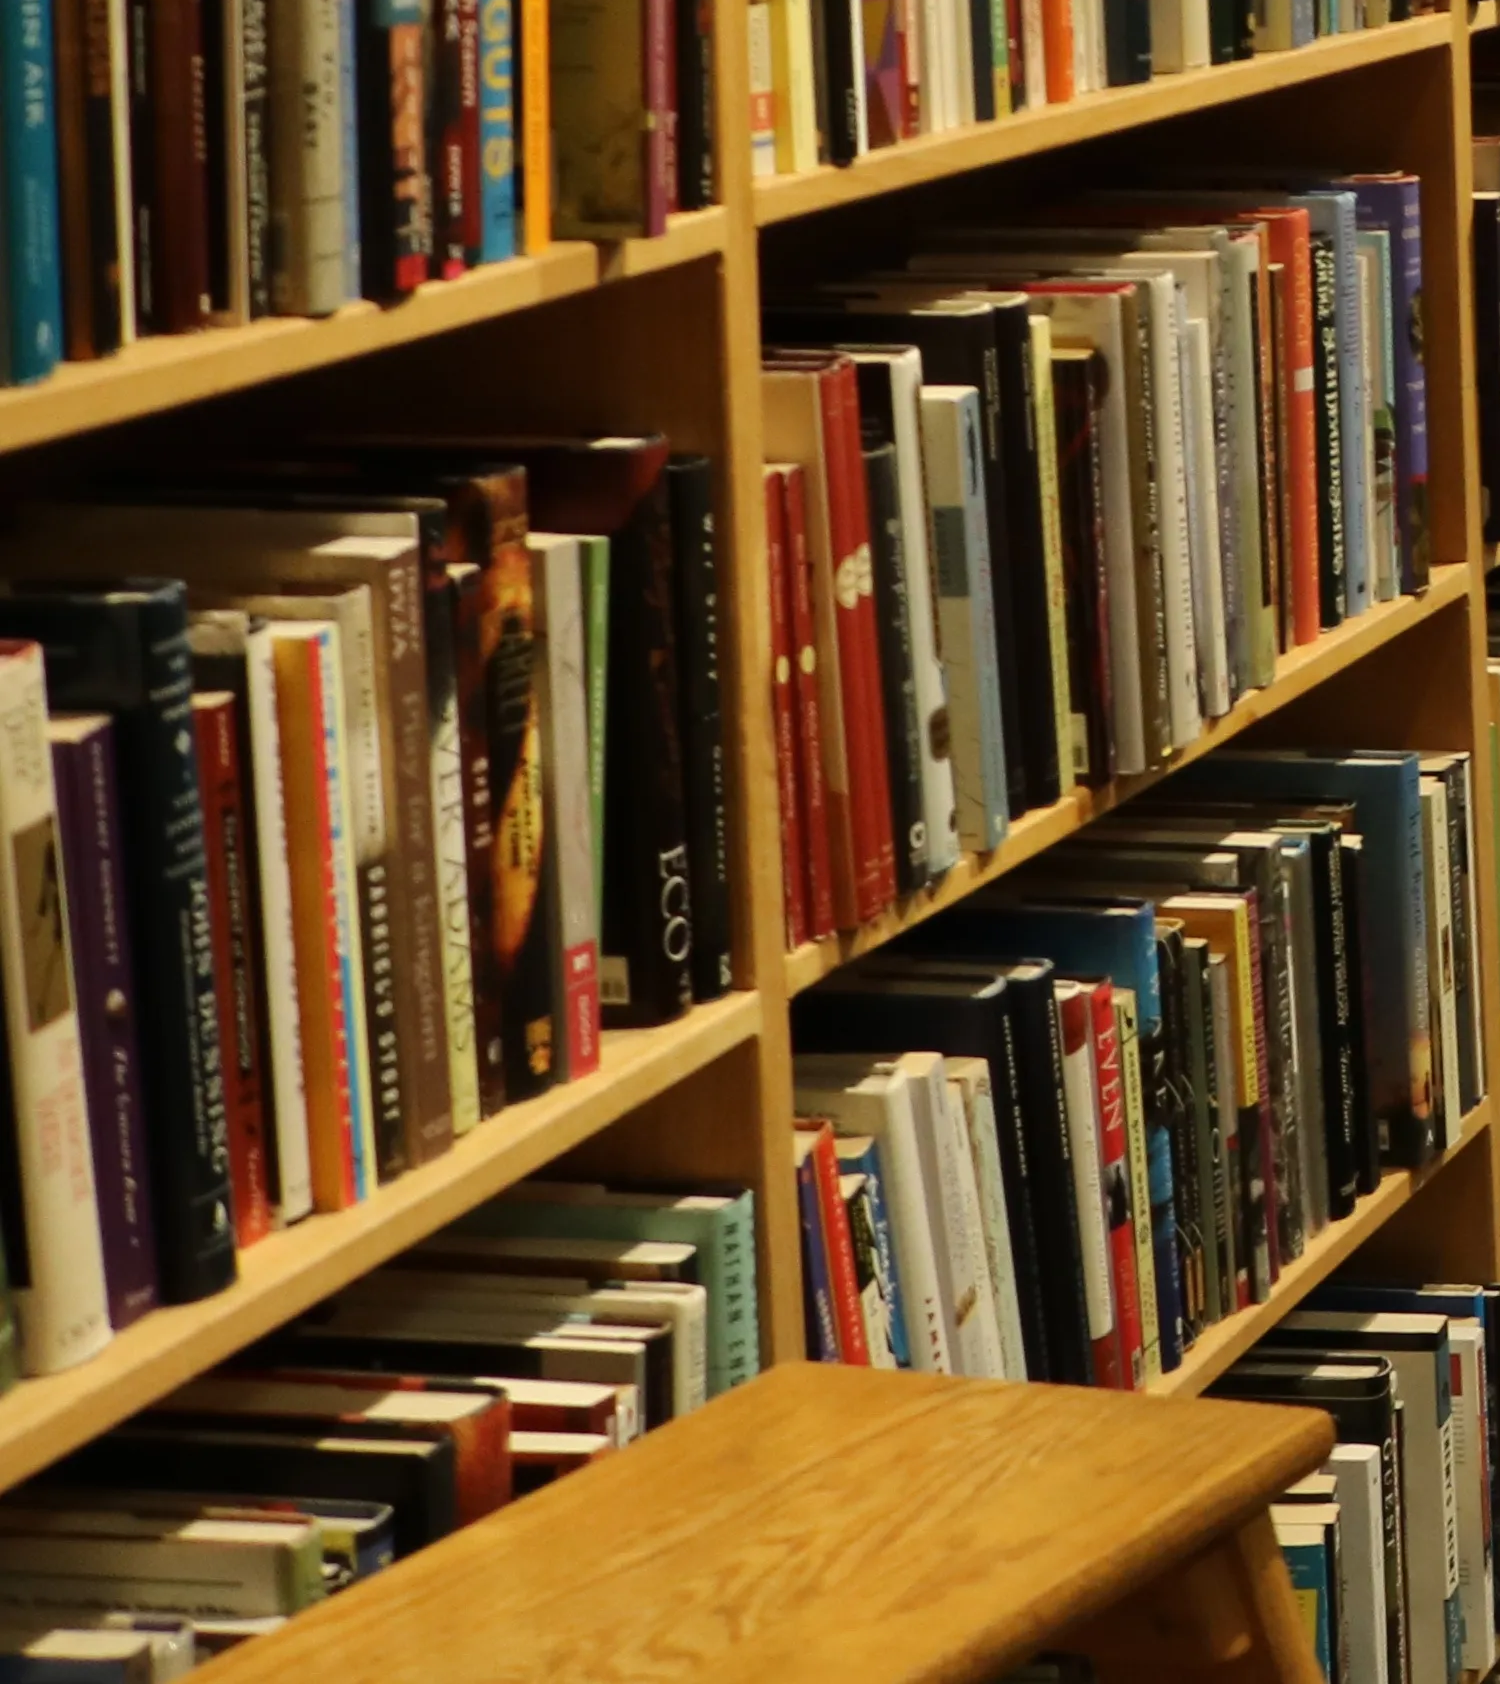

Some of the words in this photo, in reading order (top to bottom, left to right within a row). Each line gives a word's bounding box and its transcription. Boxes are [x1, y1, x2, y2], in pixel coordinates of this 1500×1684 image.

[23, 62, 44, 129] AIR
[462, 20, 478, 107] Season
[400, 691, 426, 775] Play
[405, 794, 428, 850] for
[188, 878, 213, 976] JOHN
[371, 865, 393, 1018] GABRIEL'S
[443, 855, 474, 1052] ADAMS
[658, 845, 692, 963] ECO
[413, 897, 439, 1063] Kingdom
[1276, 969, 1294, 1047] Little
[196, 991, 229, 1176] DUNNING
[378, 1032, 399, 1122] STORY
[1002, 1013, 1017, 1100] MITCHELL
[1013, 1105, 1028, 1178] GRAHAM
[1047, 998, 1061, 1083] MITCHELL
[1056, 1087, 1071, 1161] GRAHAM
[1097, 1026, 1123, 1133] EVEN
[1245, 1025, 1259, 1106] DOTING
[1283, 1058, 1299, 1136] Saint
[1134, 1171, 1148, 1219] world
[721, 1221, 746, 1326] NATHAN
[837, 1235, 864, 1354] DAUGHTER
